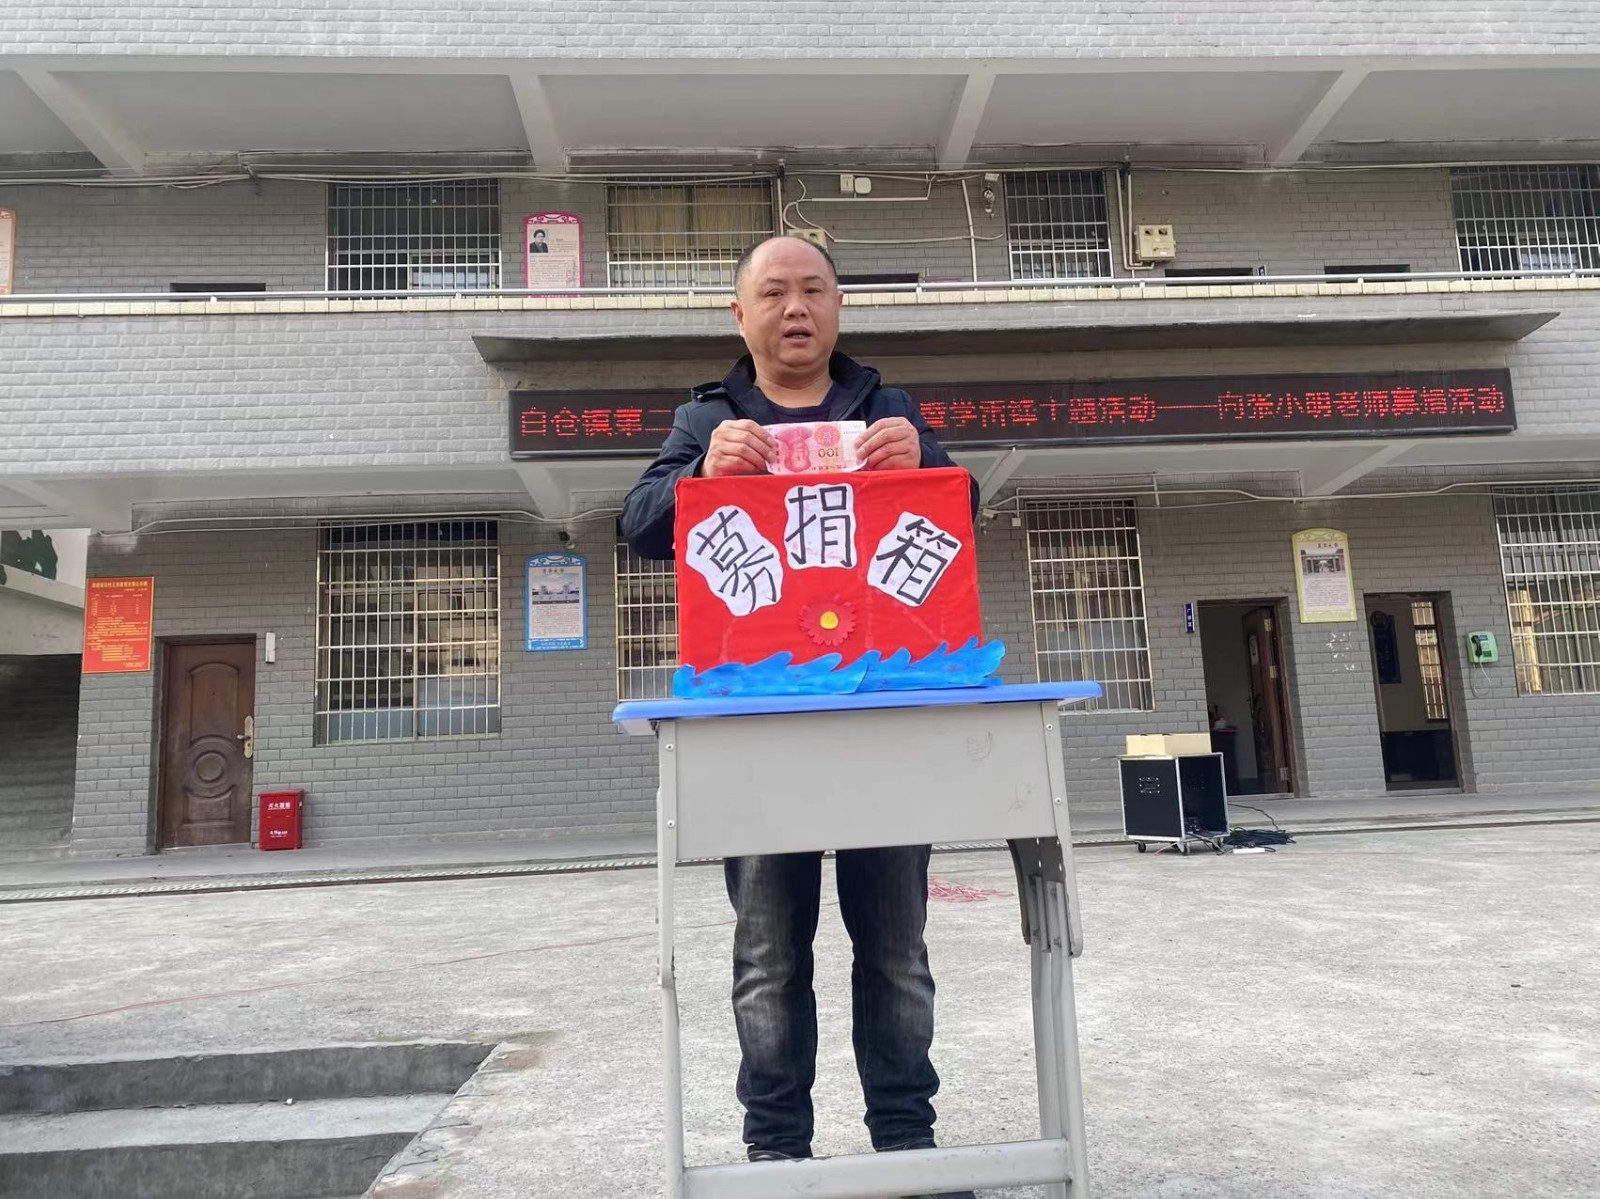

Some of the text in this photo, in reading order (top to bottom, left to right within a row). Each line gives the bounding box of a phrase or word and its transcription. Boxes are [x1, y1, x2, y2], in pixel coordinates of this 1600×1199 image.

[818, 447, 840, 458] 100
[695, 484, 959, 612] 募捐箱
